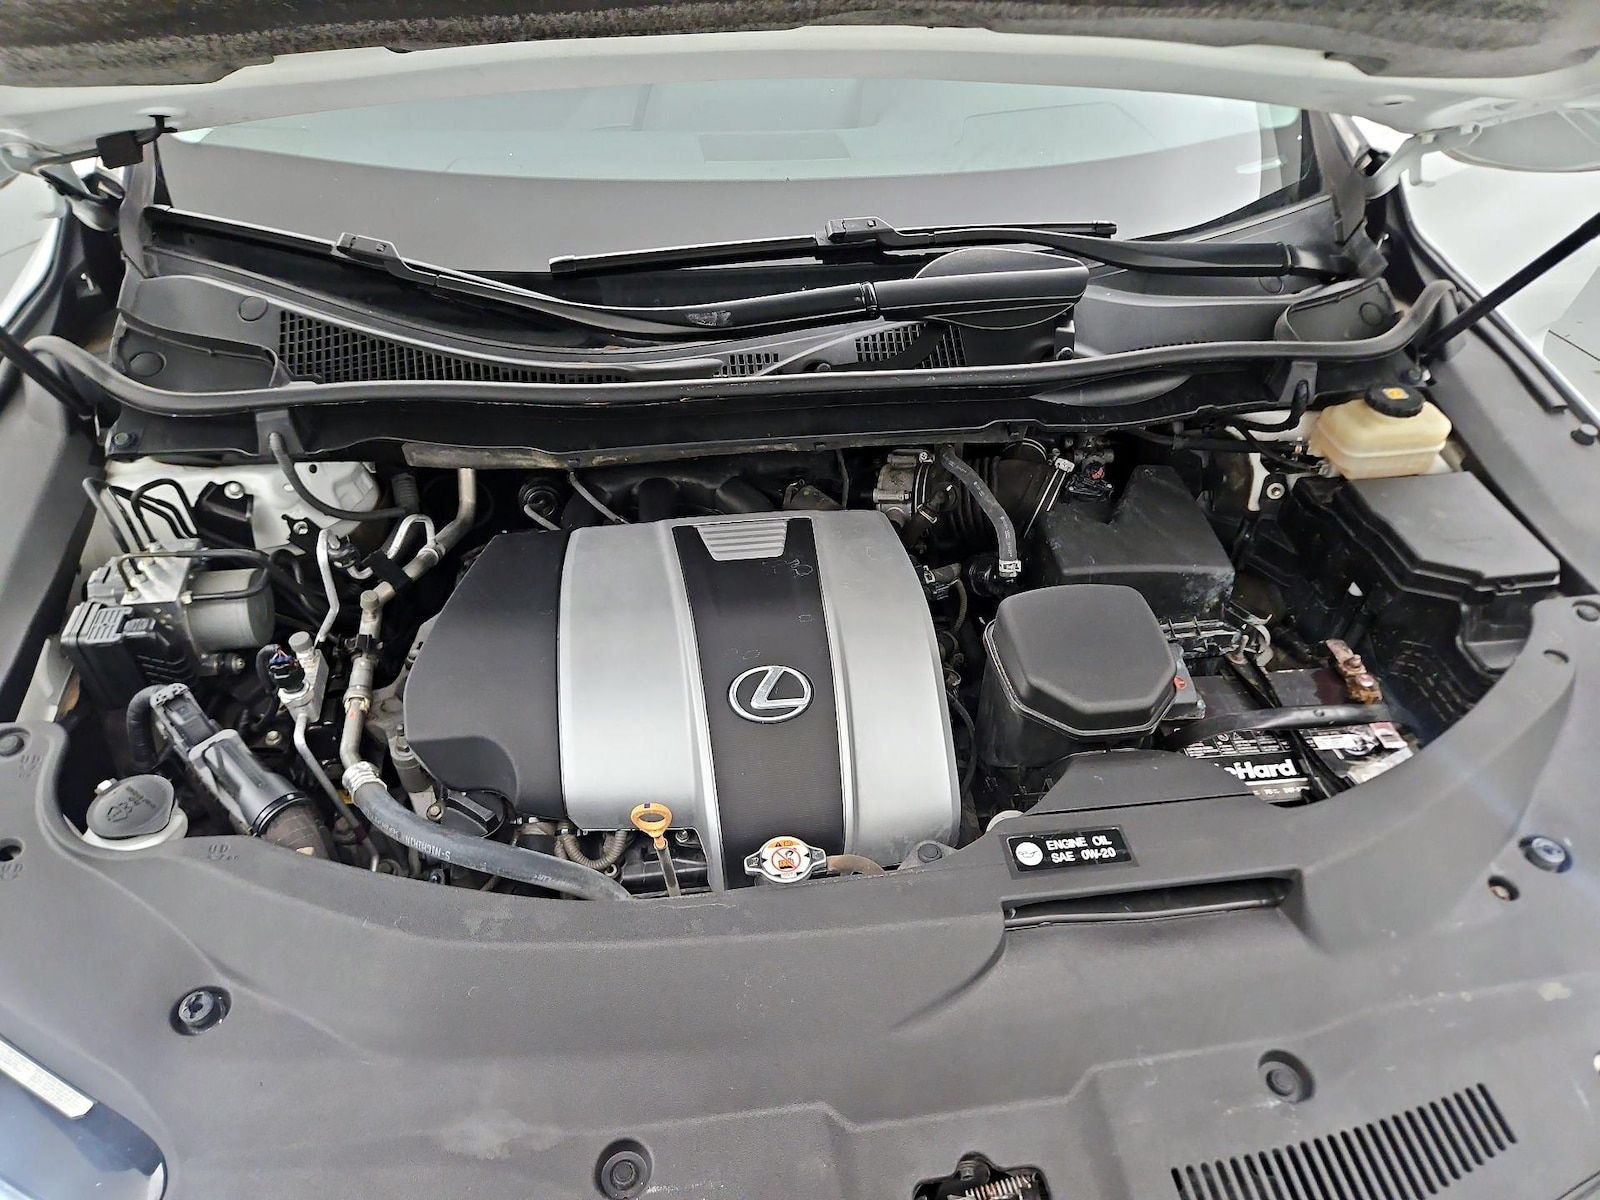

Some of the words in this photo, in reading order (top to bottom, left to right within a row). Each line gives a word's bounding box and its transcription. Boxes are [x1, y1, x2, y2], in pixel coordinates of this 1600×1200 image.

[1218, 758, 1298, 780] Hard
[1045, 836, 1088, 851] ENGINE
[1092, 834, 1113, 847] OIL
[1050, 850, 1076, 863] SAE
[1080, 847, 1117, 860] 0W-20
